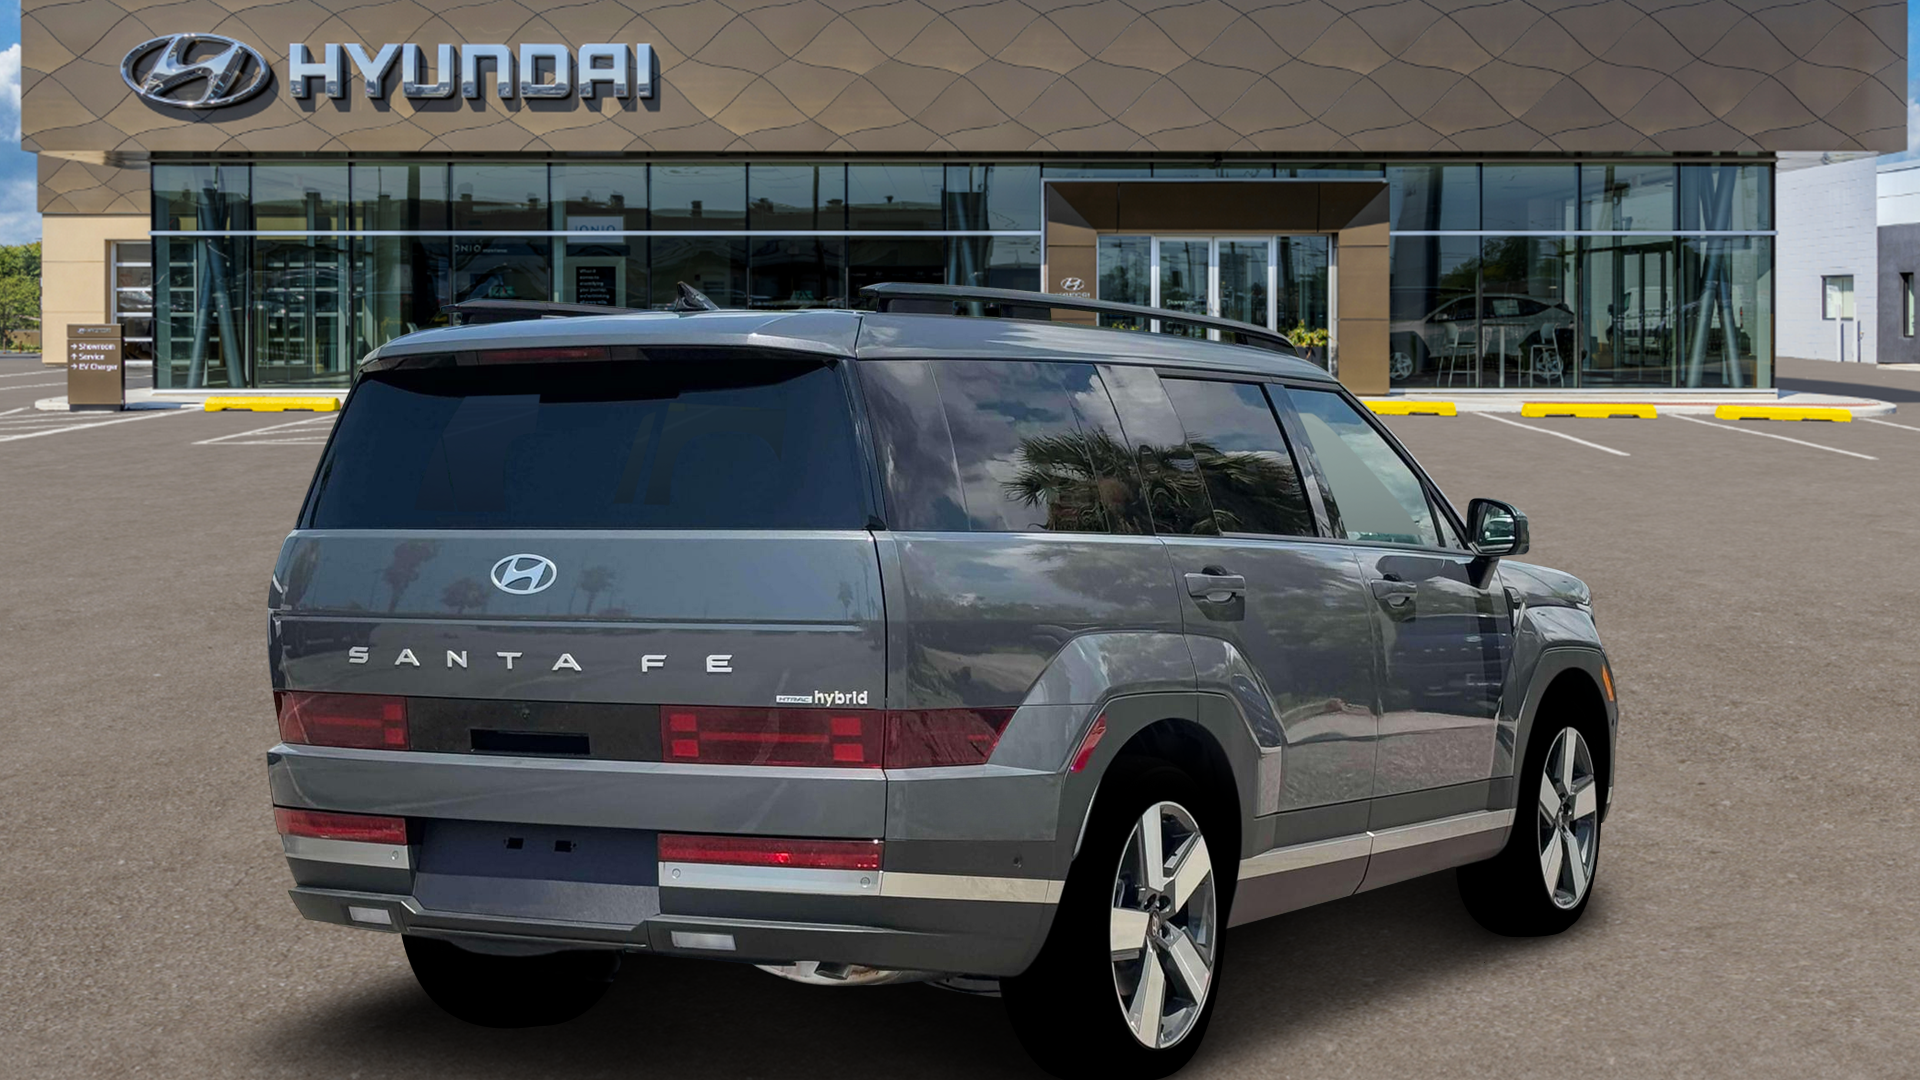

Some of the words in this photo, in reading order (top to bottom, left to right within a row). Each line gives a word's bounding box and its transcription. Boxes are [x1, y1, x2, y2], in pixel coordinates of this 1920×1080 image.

[289, 43, 653, 98] HYUNDAI
[78, 352, 105, 360] Service
[90, 363, 118, 372] Charger
[348, 646, 582, 672] SANTA
[641, 654, 733, 673] FE
[814, 690, 868, 707] hybrid
